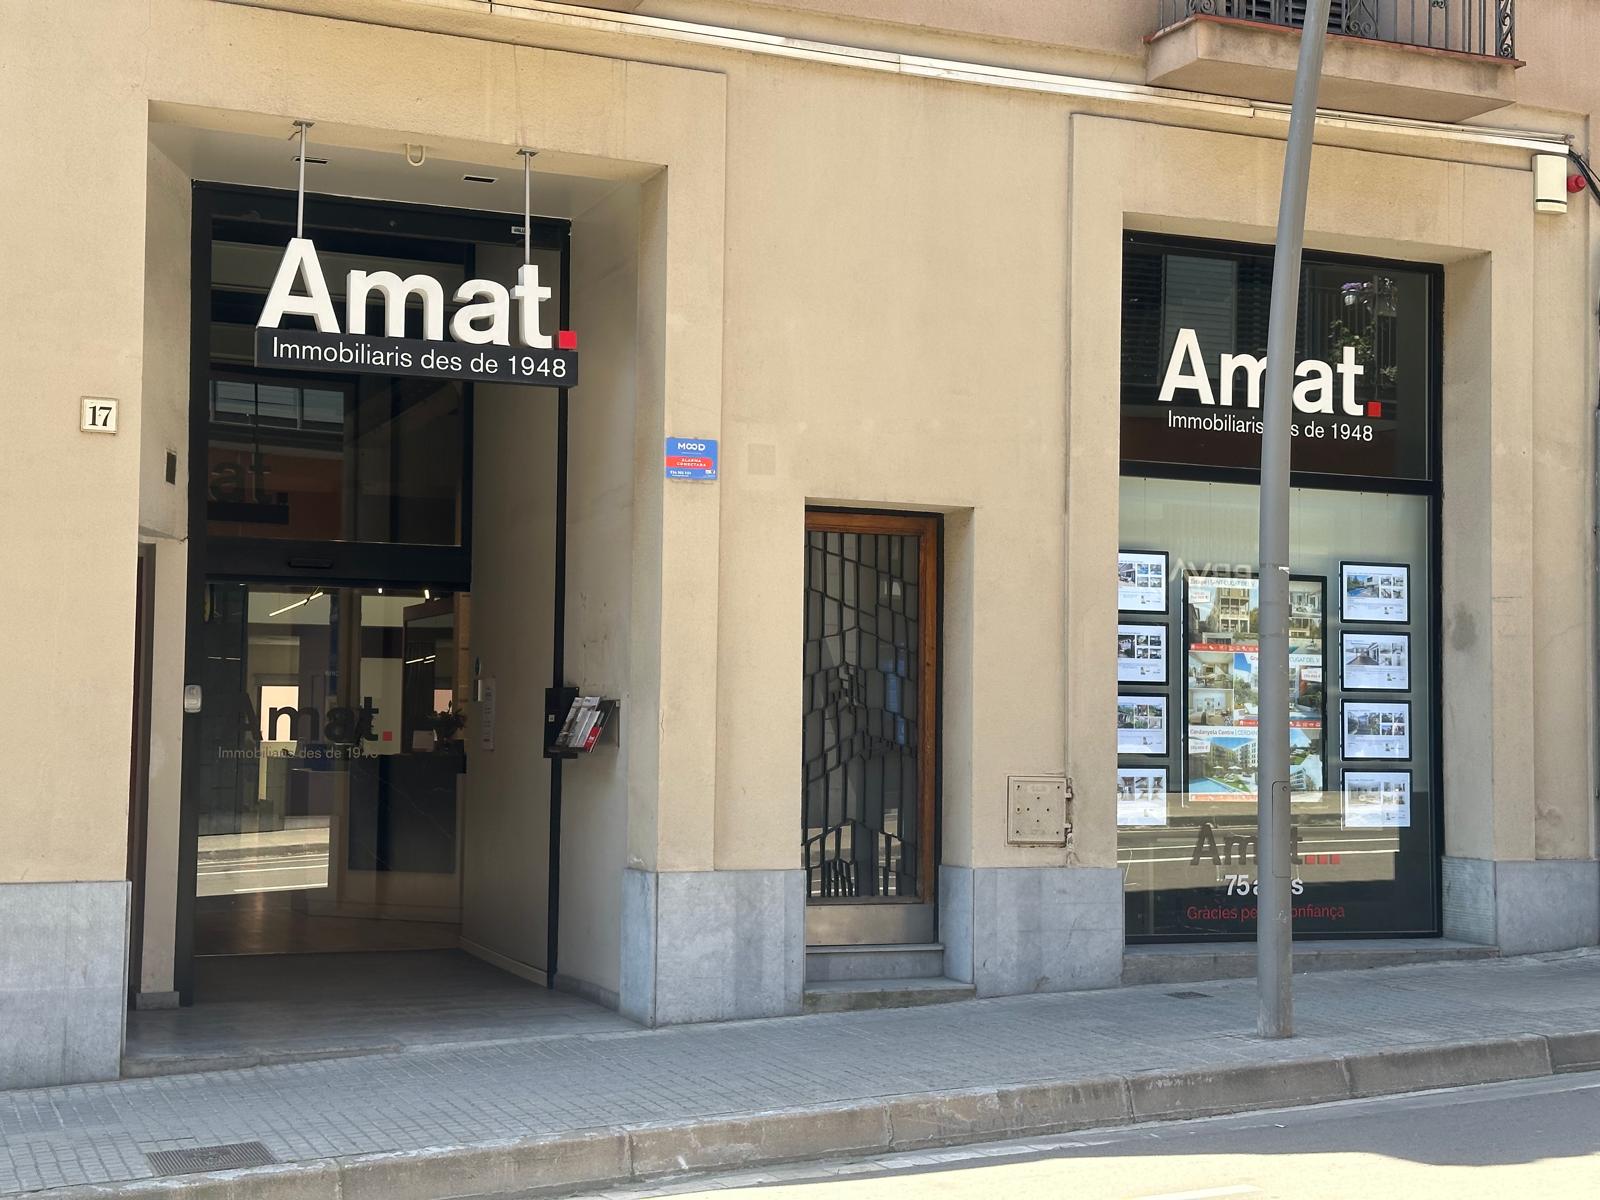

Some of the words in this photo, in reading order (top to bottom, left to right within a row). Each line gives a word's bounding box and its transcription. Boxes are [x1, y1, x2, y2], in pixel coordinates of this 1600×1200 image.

[273, 336, 412, 368] Immobiliaris
[420, 350, 462, 372] des
[470, 353, 498, 374] de
[508, 355, 567, 378] 1948
[88, 405, 112, 427] 17
[1168, 410, 1264, 434] Immobiliaris
[1304, 421, 1325, 439] de
[1331, 423, 1373, 442] 1948
[677, 442, 706, 451] MOOD
[300, 747, 321, 760] des
[325, 747, 342, 760] de
[1224, 874, 1250, 896] 75
[1187, 905, 1238, 920] Gràcies
[1241, 908, 1258, 922] pe
[1291, 904, 1345, 920] onfiança
